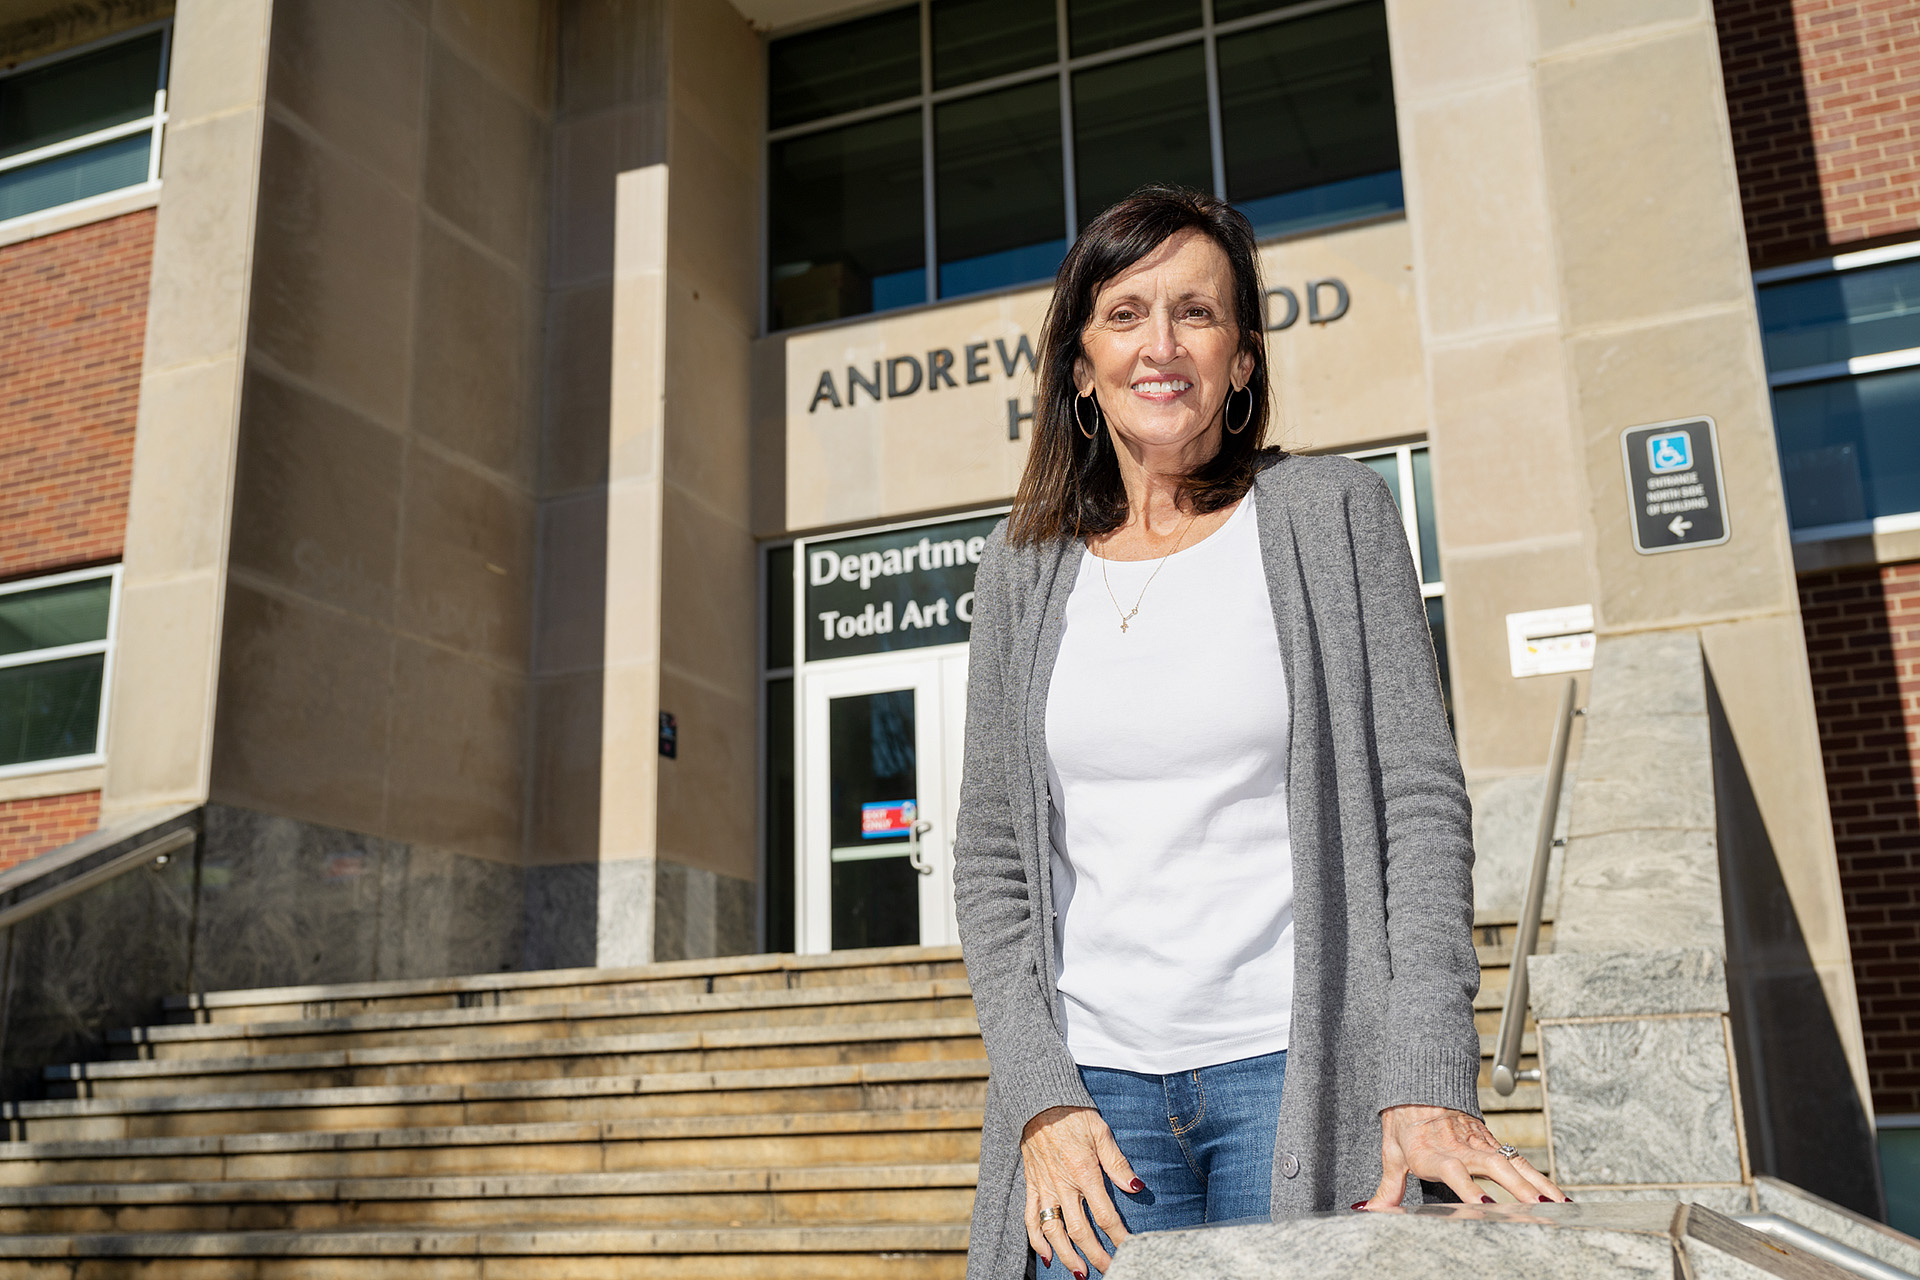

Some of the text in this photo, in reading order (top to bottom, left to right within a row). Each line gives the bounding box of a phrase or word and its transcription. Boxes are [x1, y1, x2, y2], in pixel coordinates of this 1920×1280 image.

[1647, 471, 1699, 490] ENTRANCE
[1646, 483, 1705, 503] NORTH SIDE
[1646, 496, 1709, 516] OF BUILDING
[818, 601, 894, 641] Todd
[899, 597, 949, 631] Art
